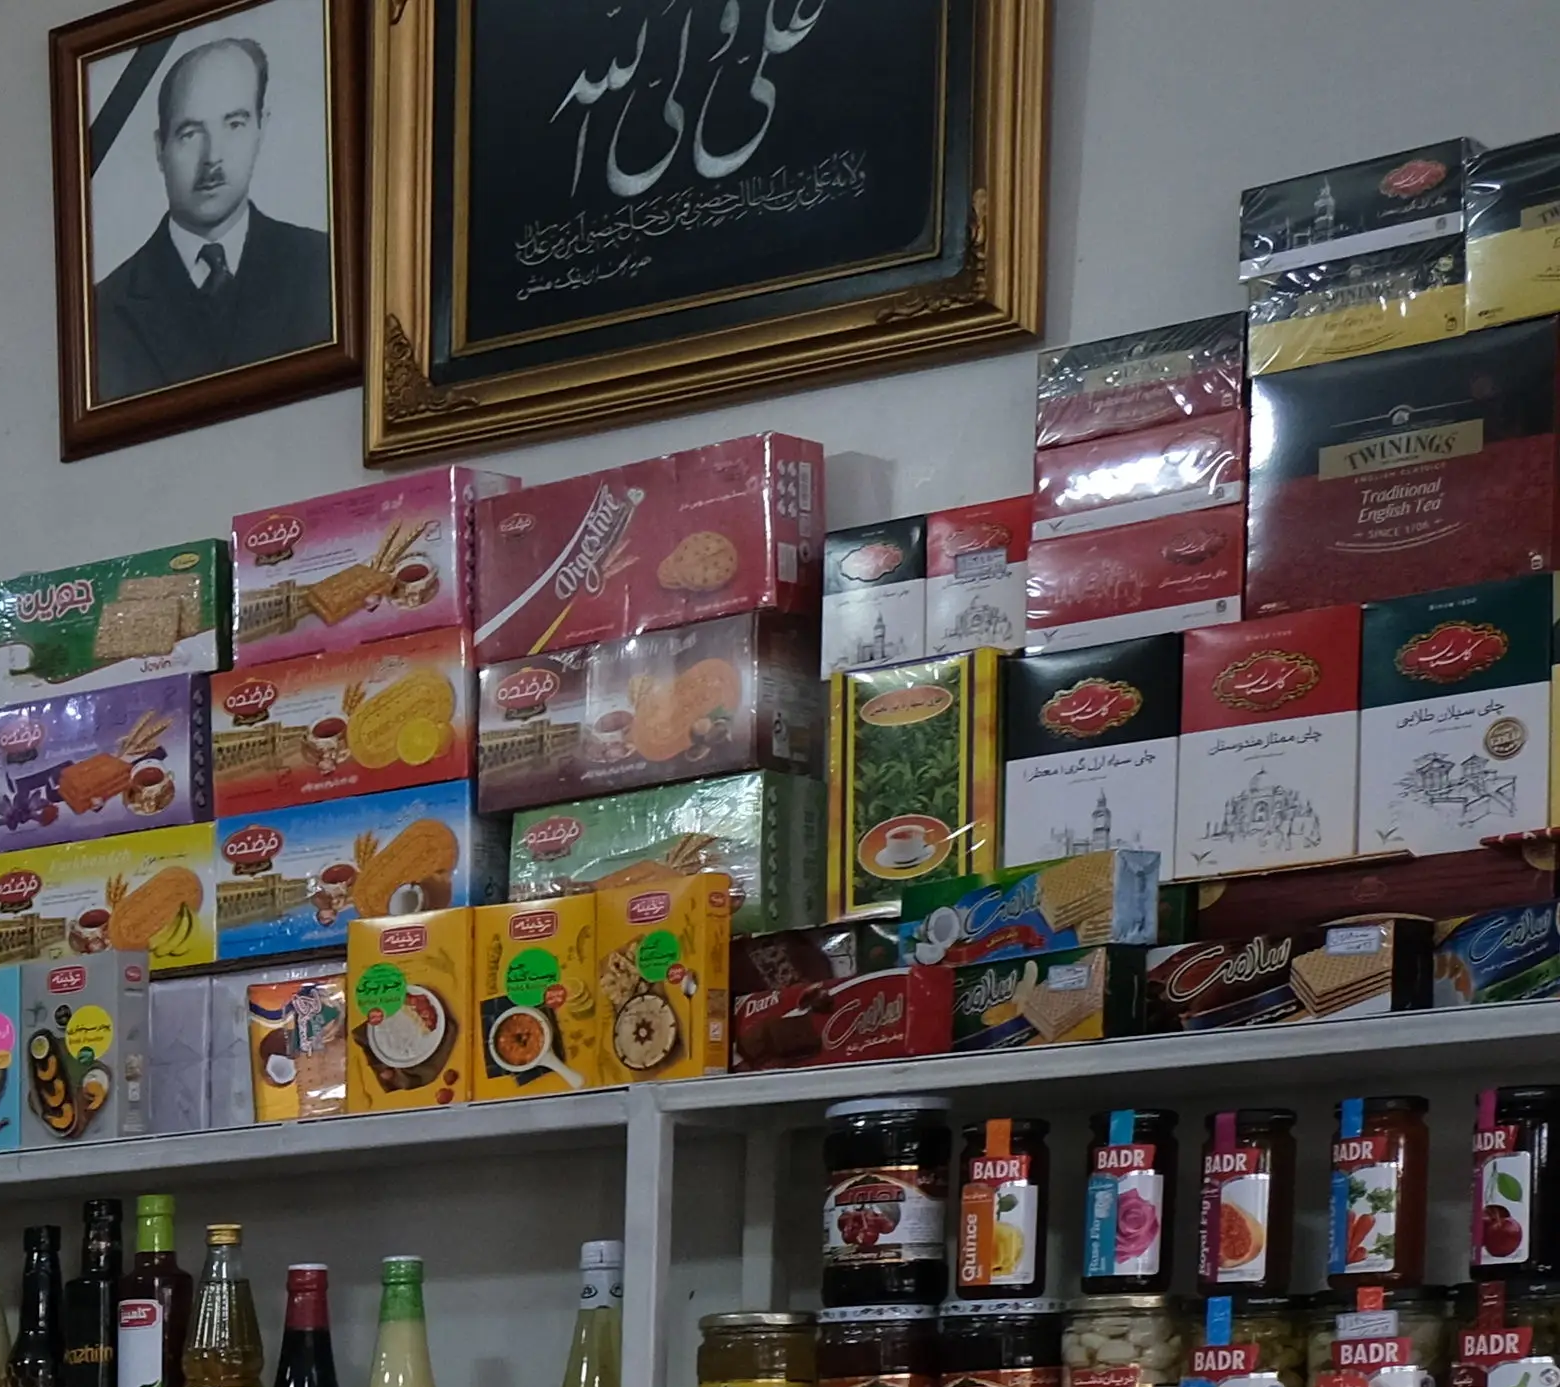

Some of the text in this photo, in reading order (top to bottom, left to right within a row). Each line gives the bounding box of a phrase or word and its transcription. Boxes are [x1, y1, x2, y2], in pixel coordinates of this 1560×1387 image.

[1344, 432, 1457, 472] TWININGS
[1360, 476, 1443, 507] Traditional
[1357, 495, 1442, 525] English Tea
[18, 576, 94, 623] جوین
[139, 655, 171, 673] Jovin
[744, 990, 781, 1015] Dark
[1096, 1148, 1146, 1169] BADR
[1204, 1153, 1248, 1173] BADR
[1332, 1142, 1374, 1163] BADR
[972, 1160, 1020, 1181] BADR
[962, 1212, 978, 1282] Quince
[1339, 1342, 1399, 1366] BADR
[1463, 1332, 1520, 1357] BADR
[1193, 1349, 1246, 1372] BADR
